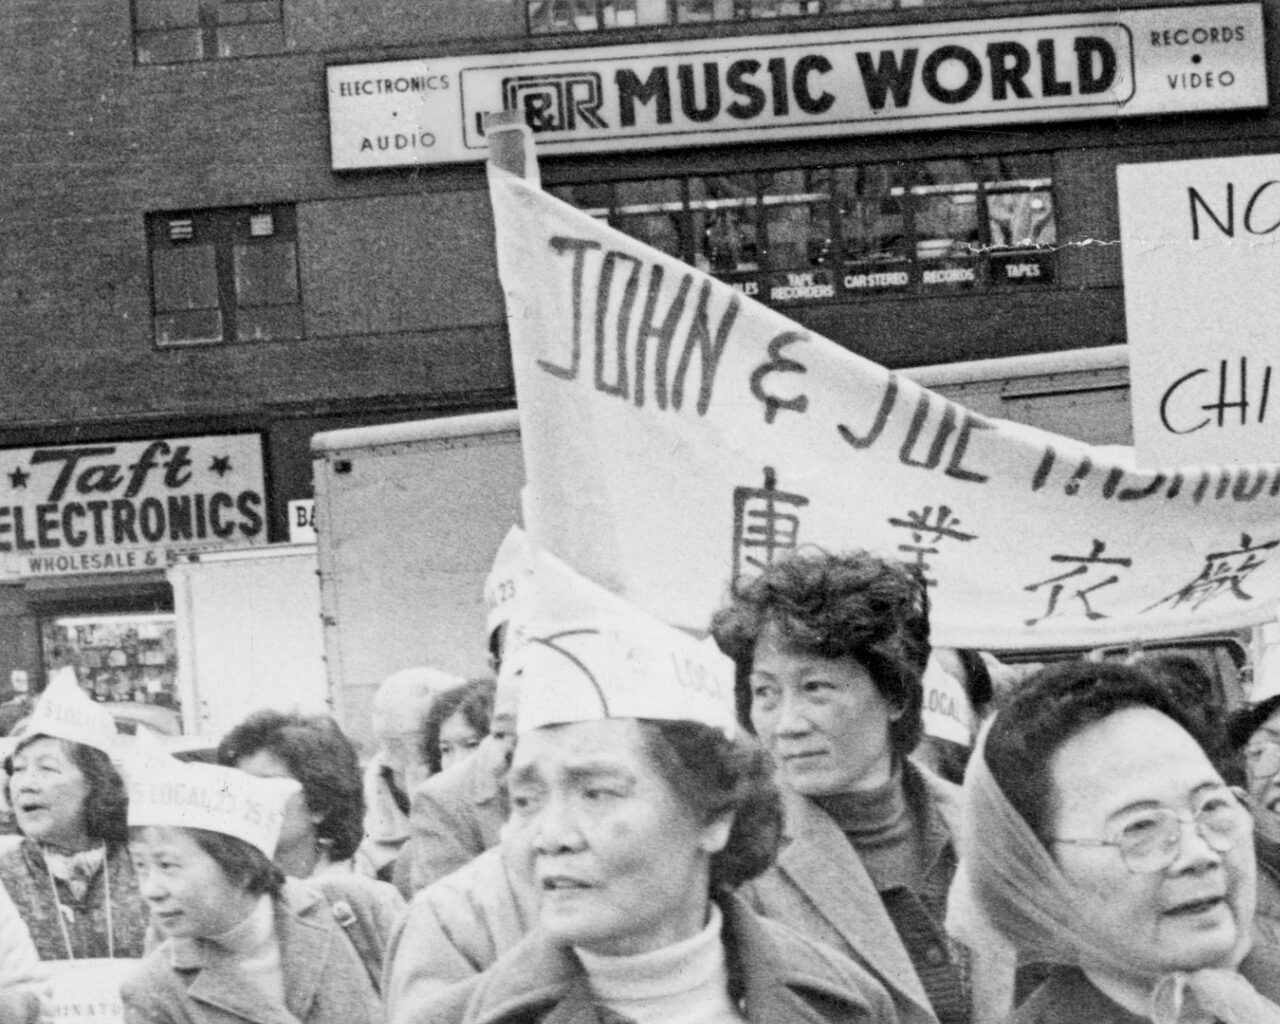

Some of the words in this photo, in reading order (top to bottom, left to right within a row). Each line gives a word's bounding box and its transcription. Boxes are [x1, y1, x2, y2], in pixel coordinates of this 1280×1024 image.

[1151, 25, 1246, 47] RECORDS
[339, 75, 450, 98] ELECTRONICS
[616, 56, 837, 124] MUSIC
[855, 35, 1119, 112] WORLD
[1167, 70, 1235, 92] VIDEO
[359, 132, 436, 152] AUDIO
[923, 268, 975, 284] RECORDS
[1005, 263, 1041, 278] TAPES
[536, 235, 741, 417] JOHN
[750, 330, 811, 424] &
[29, 441, 193, 502] Taft
[28, 553, 137, 574] WHOLESALE
[144, 550, 158, 566] &
